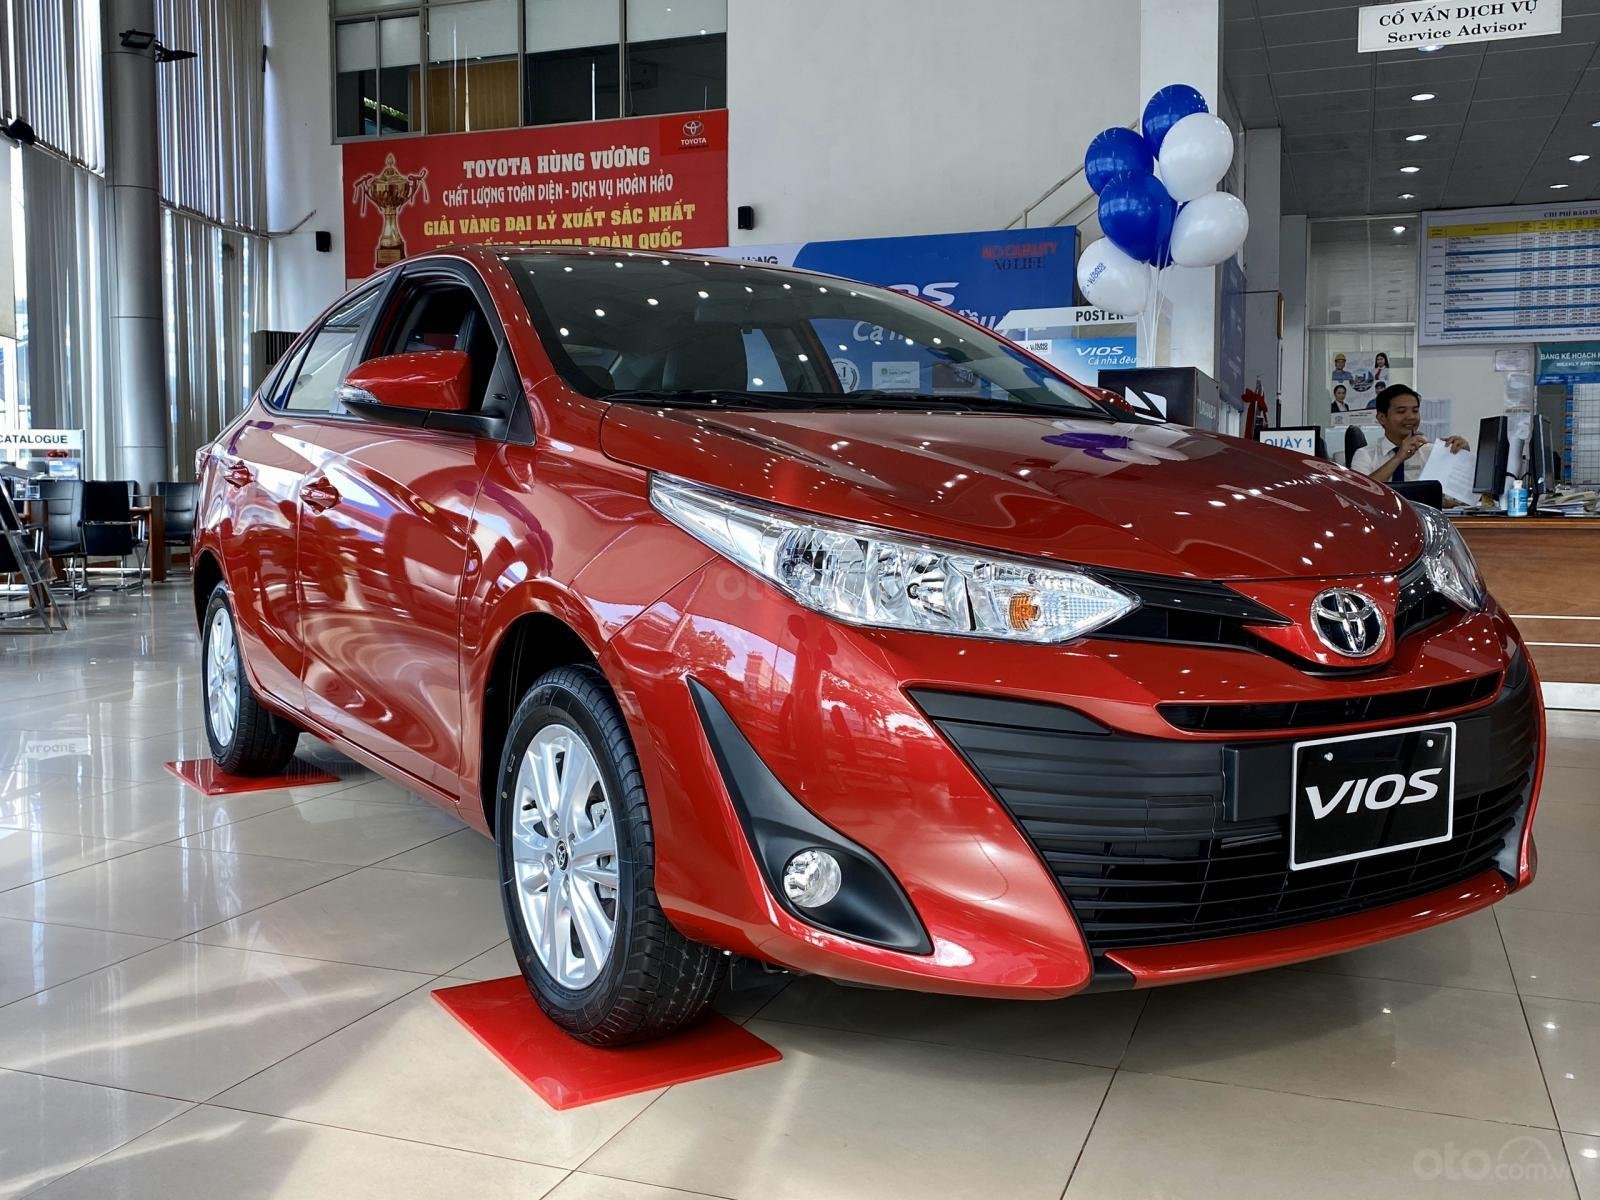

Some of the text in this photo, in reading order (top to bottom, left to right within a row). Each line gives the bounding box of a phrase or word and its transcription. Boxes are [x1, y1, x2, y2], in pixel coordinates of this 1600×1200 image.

[1379, 0, 1538, 26] CỐ VẤN DỊCH VỤ
[1387, 22, 1528, 44] Service Advisor
[681, 137, 707, 146] TOYOTA
[463, 145, 650, 179] TOYOTA HÙNG VƯƠNG
[442, 184, 468, 208] CHẤT
[471, 186, 505, 208] LƯỢNG
[507, 181, 535, 203] TOÀN
[538, 180, 563, 204] DIỆN
[571, 180, 596, 202] DỊCH
[599, 179, 613, 200] VỤ
[616, 173, 647, 197] HOÀN
[650, 168, 674, 194] HẢO
[424, 199, 696, 236] GIẢI VÀNG ĐẠI LÝ XUẤT SẮC NHẤT
[639, 225, 682, 249] QUỐC
[1076, 346, 1124, 356] VIOS
[1305, 767, 1443, 820] VIOS
